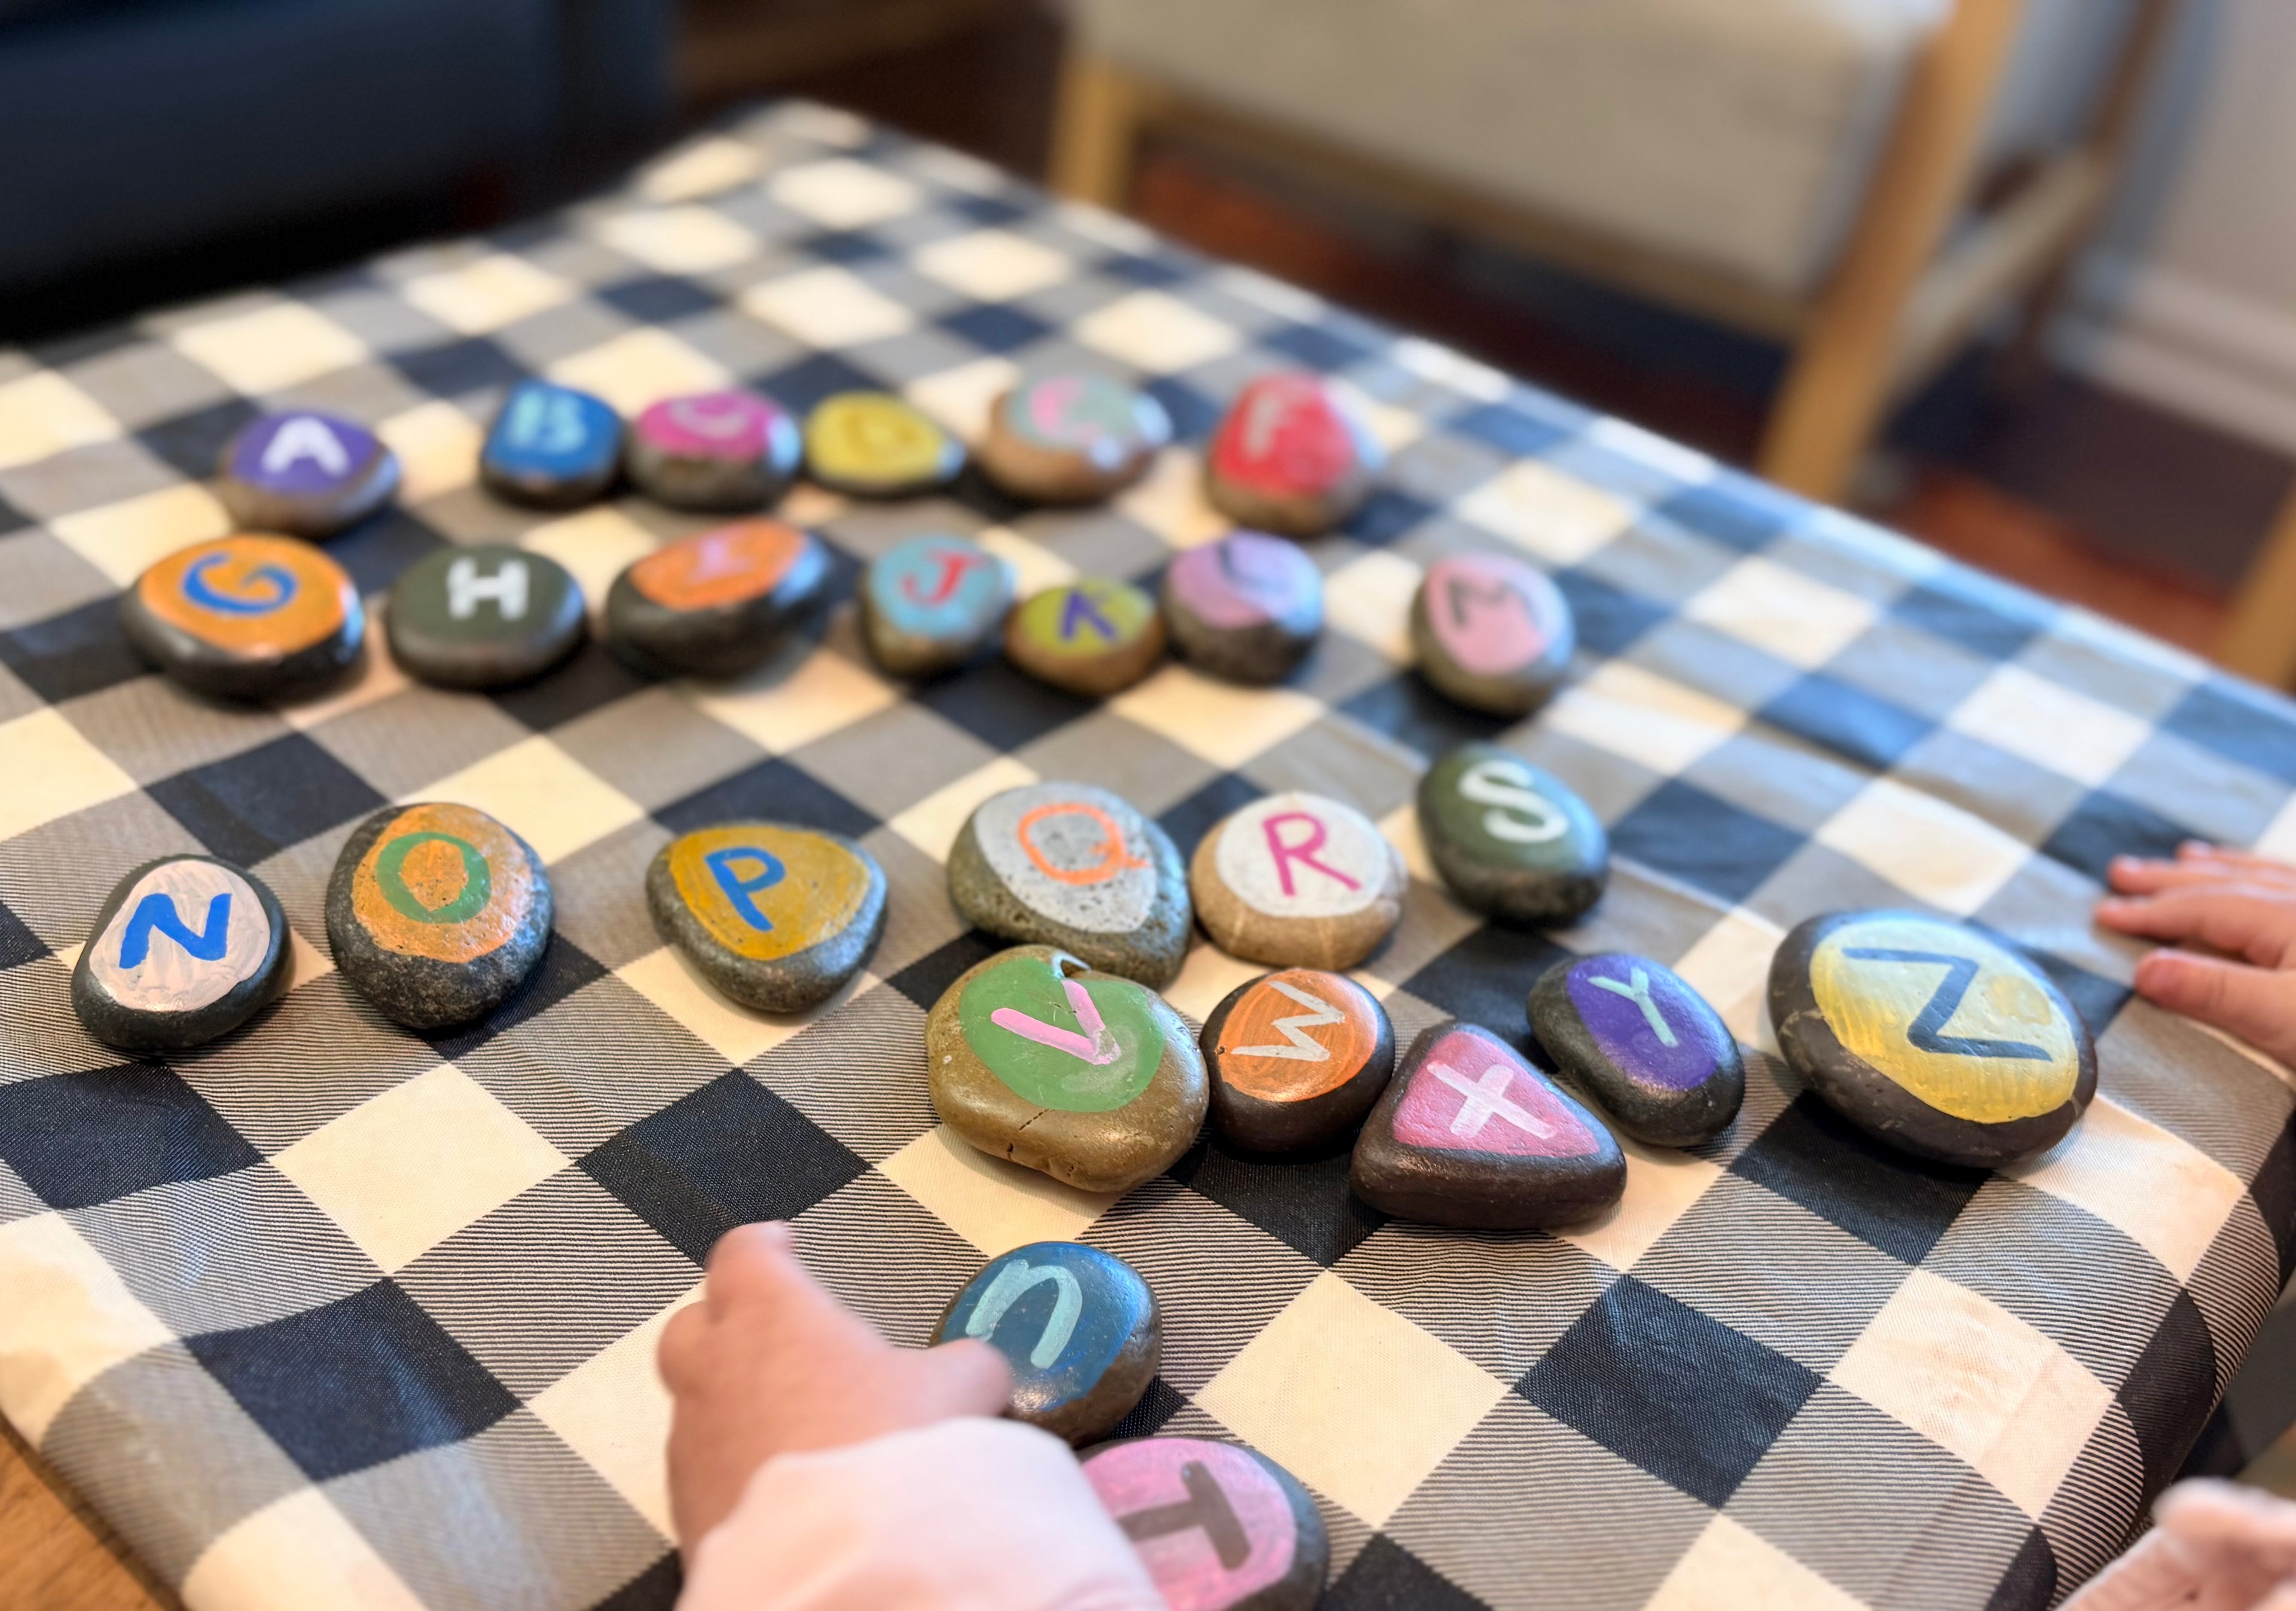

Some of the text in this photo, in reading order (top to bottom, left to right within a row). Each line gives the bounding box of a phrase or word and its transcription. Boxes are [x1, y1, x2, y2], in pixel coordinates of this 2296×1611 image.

[259, 416, 350, 475] A
[511, 389, 587, 453] B
[181, 549, 299, 617] G
[447, 557, 529, 622] H
[897, 547, 985, 607] J
[1058, 586, 1124, 642] K
[1446, 577, 1543, 634] M
[1457, 760, 1569, 842] S
[375, 831, 491, 924] O
[1017, 802, 1149, 885] Q
[1262, 811, 1362, 898] R
[703, 846, 786, 931] P
[119, 892, 233, 969] N
[990, 978, 1120, 1066] V
[1231, 980, 1346, 1062] W
[1587, 965, 1679, 1048] Y
[1841, 946, 2053, 1062] Z
[1426, 1062, 1557, 1140] X
[1115, 1459, 1252, 1572] T
